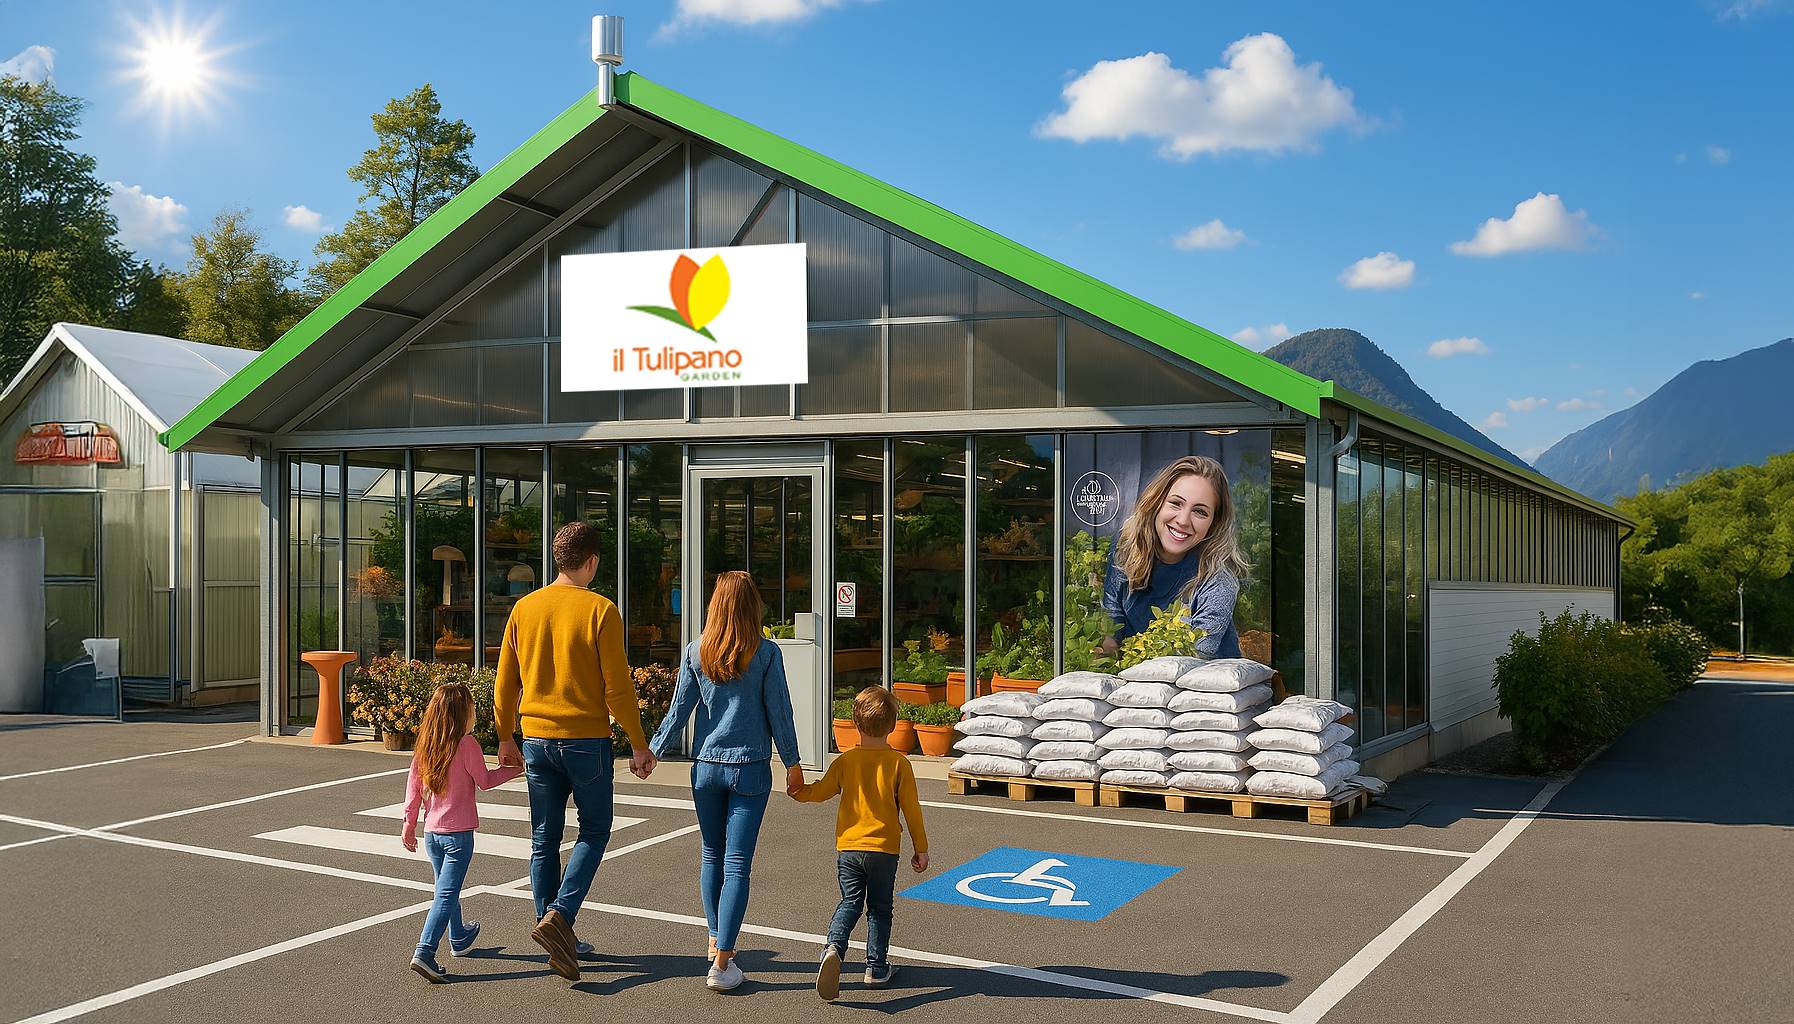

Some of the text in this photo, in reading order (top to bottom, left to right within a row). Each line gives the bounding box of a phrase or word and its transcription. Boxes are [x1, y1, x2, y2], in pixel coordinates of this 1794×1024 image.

[613, 346, 742, 376] il Tulipano
[680, 371, 742, 382] GARDEN
